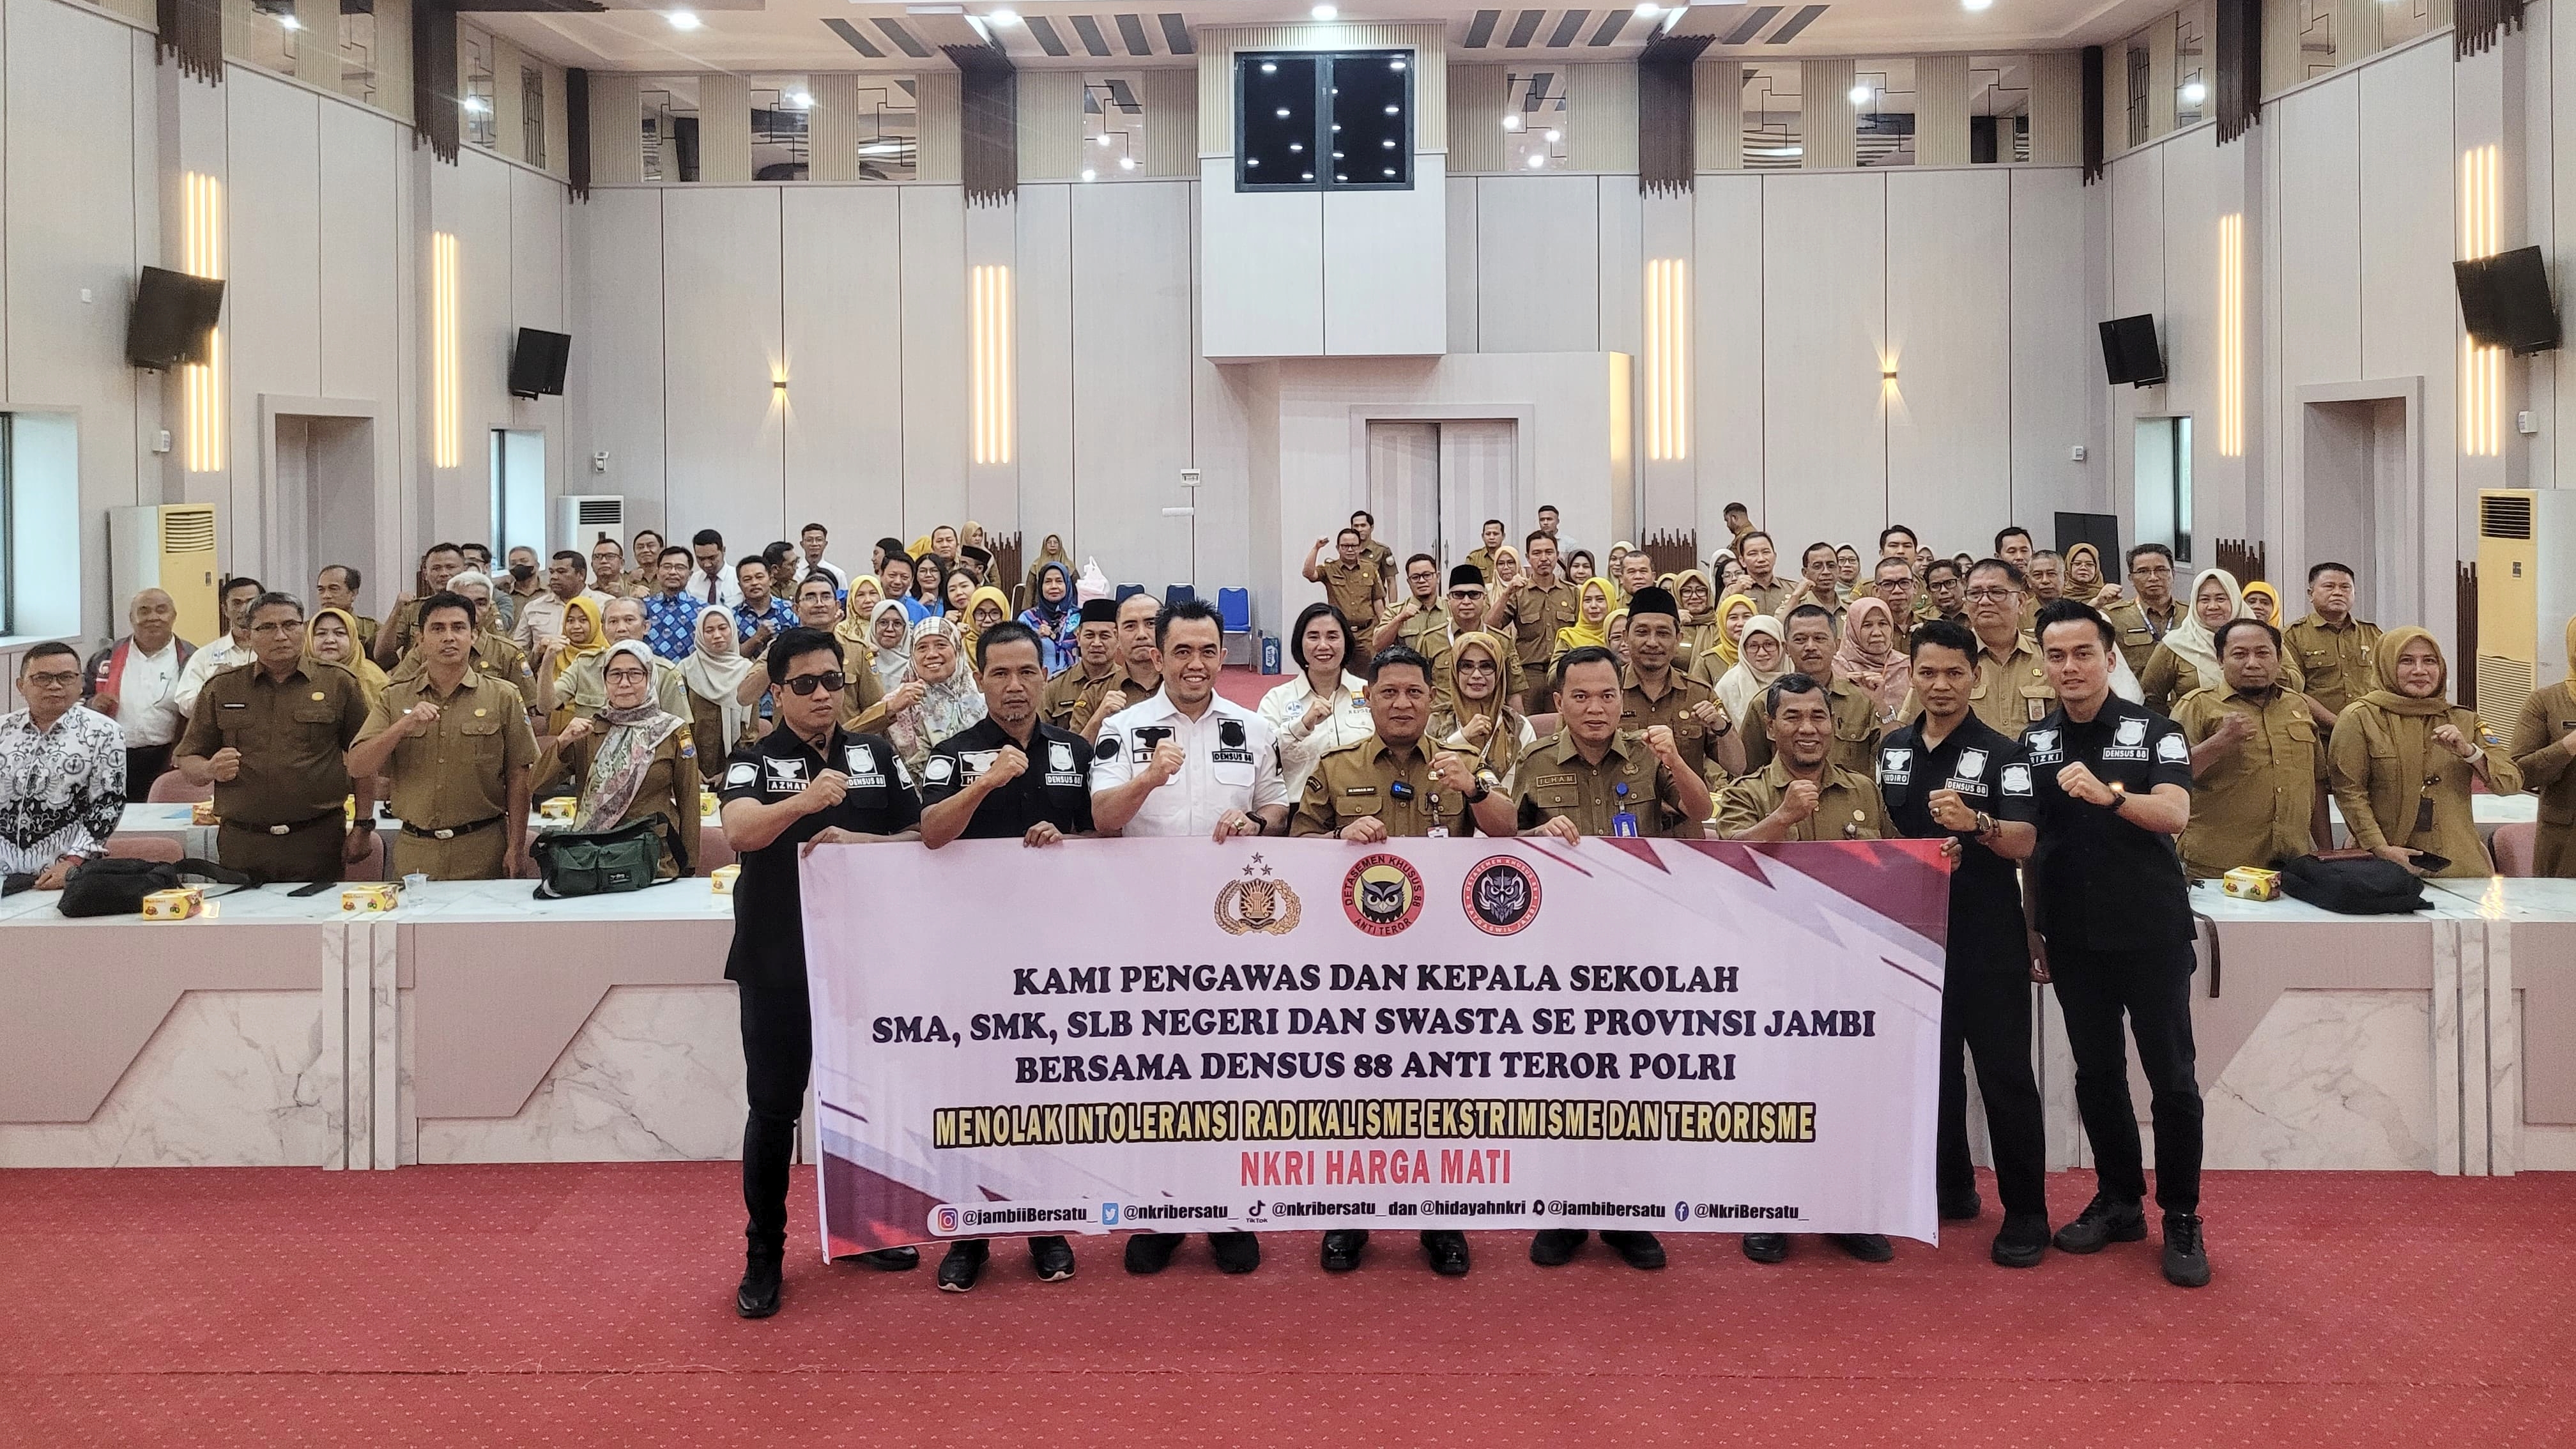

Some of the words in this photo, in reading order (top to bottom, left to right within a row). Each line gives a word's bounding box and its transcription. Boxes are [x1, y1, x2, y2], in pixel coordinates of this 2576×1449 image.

[2030, 754, 2058, 763] RIZKI
[2105, 749, 2135, 758] DENSUS
[2136, 749, 2146, 758] 88
[771, 781, 807, 790] AZHAR
[848, 777, 875, 786] DENSUS
[1048, 776, 1073, 784] DENSUS
[1540, 776, 1573, 785] ILHAM
[1947, 781, 1975, 792] DENSUS
[1976, 785, 1986, 793] 88
[1344, 855, 1385, 906] DETASEMEN
[1389, 856, 1422, 892] KHUSUS
[1413, 895, 1422, 907] 88
[1354, 918, 1376, 934] ANTI
[1379, 917, 1412, 935] TEROR
[1013, 967, 1110, 995] KAMI
[1120, 964, 1320, 992] PENGAWAS
[1330, 964, 1407, 990] DAN
[1417, 965, 1561, 991] KEPALA
[1570, 965, 1738, 992] SEKOLAH
[873, 1016, 960, 1048] SMA,
[970, 1013, 1057, 1045] SMK,
[1068, 1011, 1132, 1038] SLB
[1142, 1008, 1278, 1036] NEGERI
[1288, 1008, 1366, 1034] DAN
[1376, 1008, 1523, 1034] SWASTA
[1533, 1008, 1575, 1034] SE
[1584, 1009, 1756, 1036] PROVINSI
[1765, 1010, 1876, 1036] JAMBI
[1015, 1054, 1192, 1083] BERSAMA
[1200, 1052, 1345, 1079] DENSUS
[1354, 1054, 1392, 1078] 88
[1401, 1052, 1491, 1078] ANTI
[1500, 1052, 1620, 1078] TEROR
[1630, 1054, 1736, 1080] POLRI
[933, 1104, 1063, 1149] MENOLAK
[1066, 1101, 1238, 1144] INTOLERANSI
[1241, 1099, 1422, 1140] RADIKALISME
[1424, 1099, 1604, 1140] EKSTRIMISME
[1607, 1100, 1662, 1140] DAN
[1664, 1101, 1816, 1143] TERORISME
[1241, 1151, 1314, 1186] NKRI
[1326, 1150, 1430, 1184] HARGA
[1441, 1149, 1510, 1183] MATI
[1389, 1201, 1417, 1216] dan
[1420, 1200, 1526, 1216] @hidayahnkri
[1547, 1200, 1666, 1217] @jambibersatu
